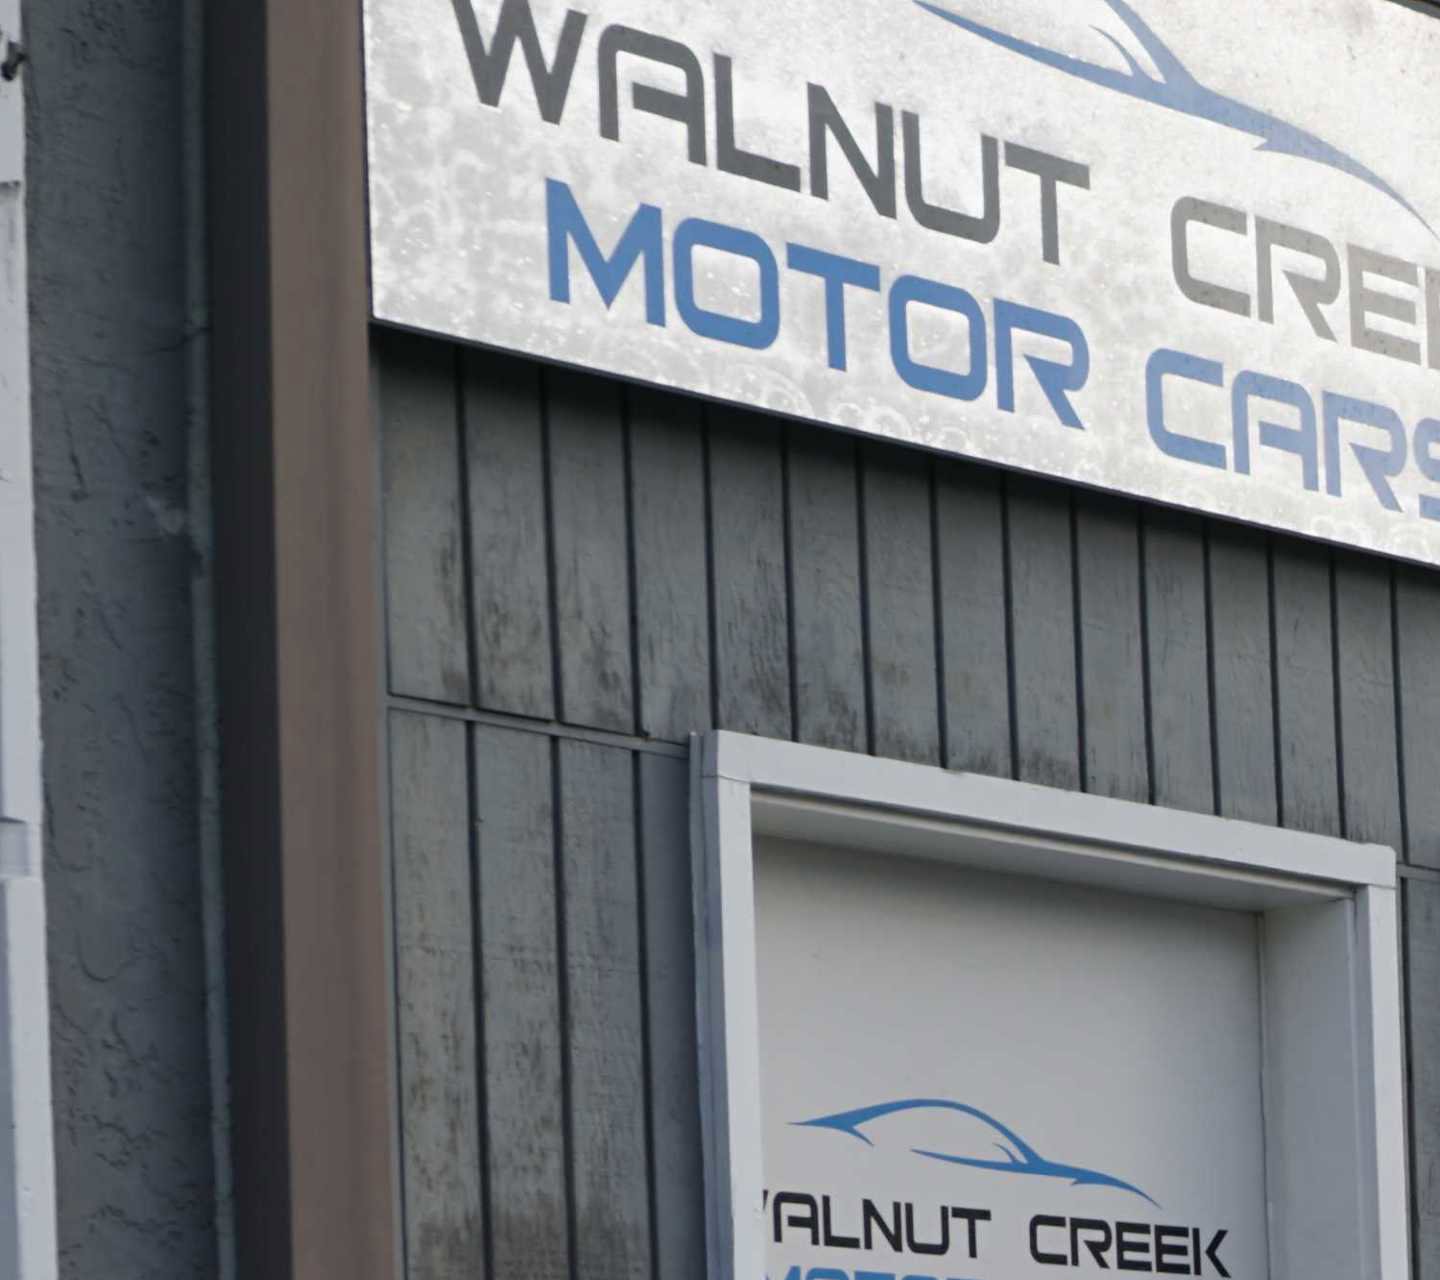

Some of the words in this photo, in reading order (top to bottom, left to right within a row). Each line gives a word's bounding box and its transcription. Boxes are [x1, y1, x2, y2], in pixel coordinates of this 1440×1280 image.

[450, 0, 1090, 266] WALNUT
[546, 177, 1090, 430] MOTOR
[763, 1189, 991, 1258] ALNUT
[1029, 1214, 1231, 1279] CREEK
